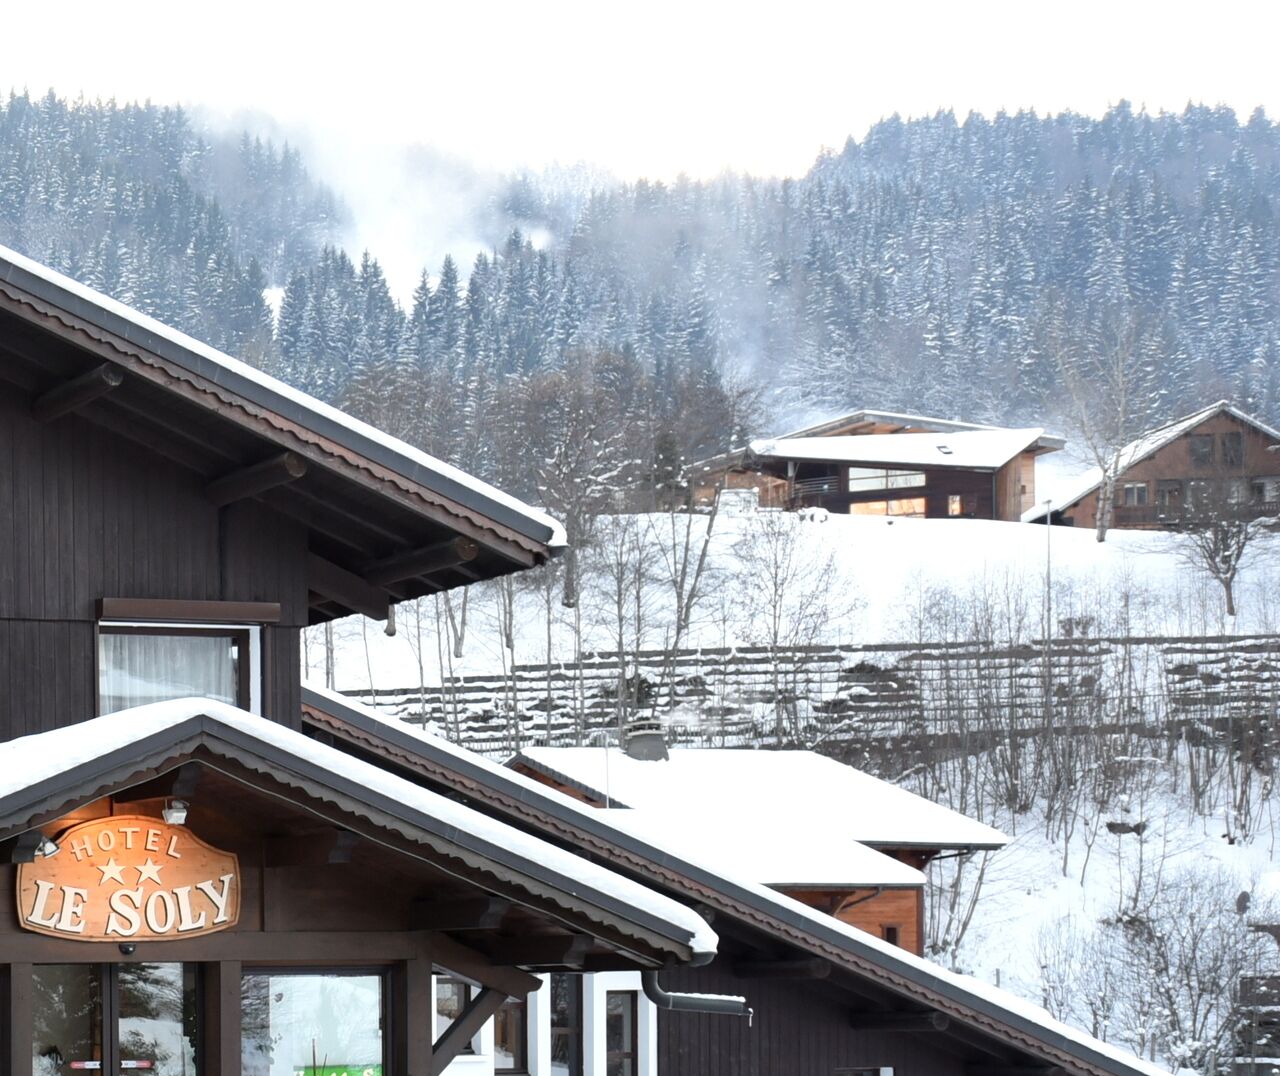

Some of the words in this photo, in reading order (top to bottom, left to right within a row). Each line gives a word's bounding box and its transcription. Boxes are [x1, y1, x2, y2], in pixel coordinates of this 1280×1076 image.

[70, 827, 182, 862] HOTEL
[26, 880, 88, 934] LE
[105, 873, 234, 937] SOLY
